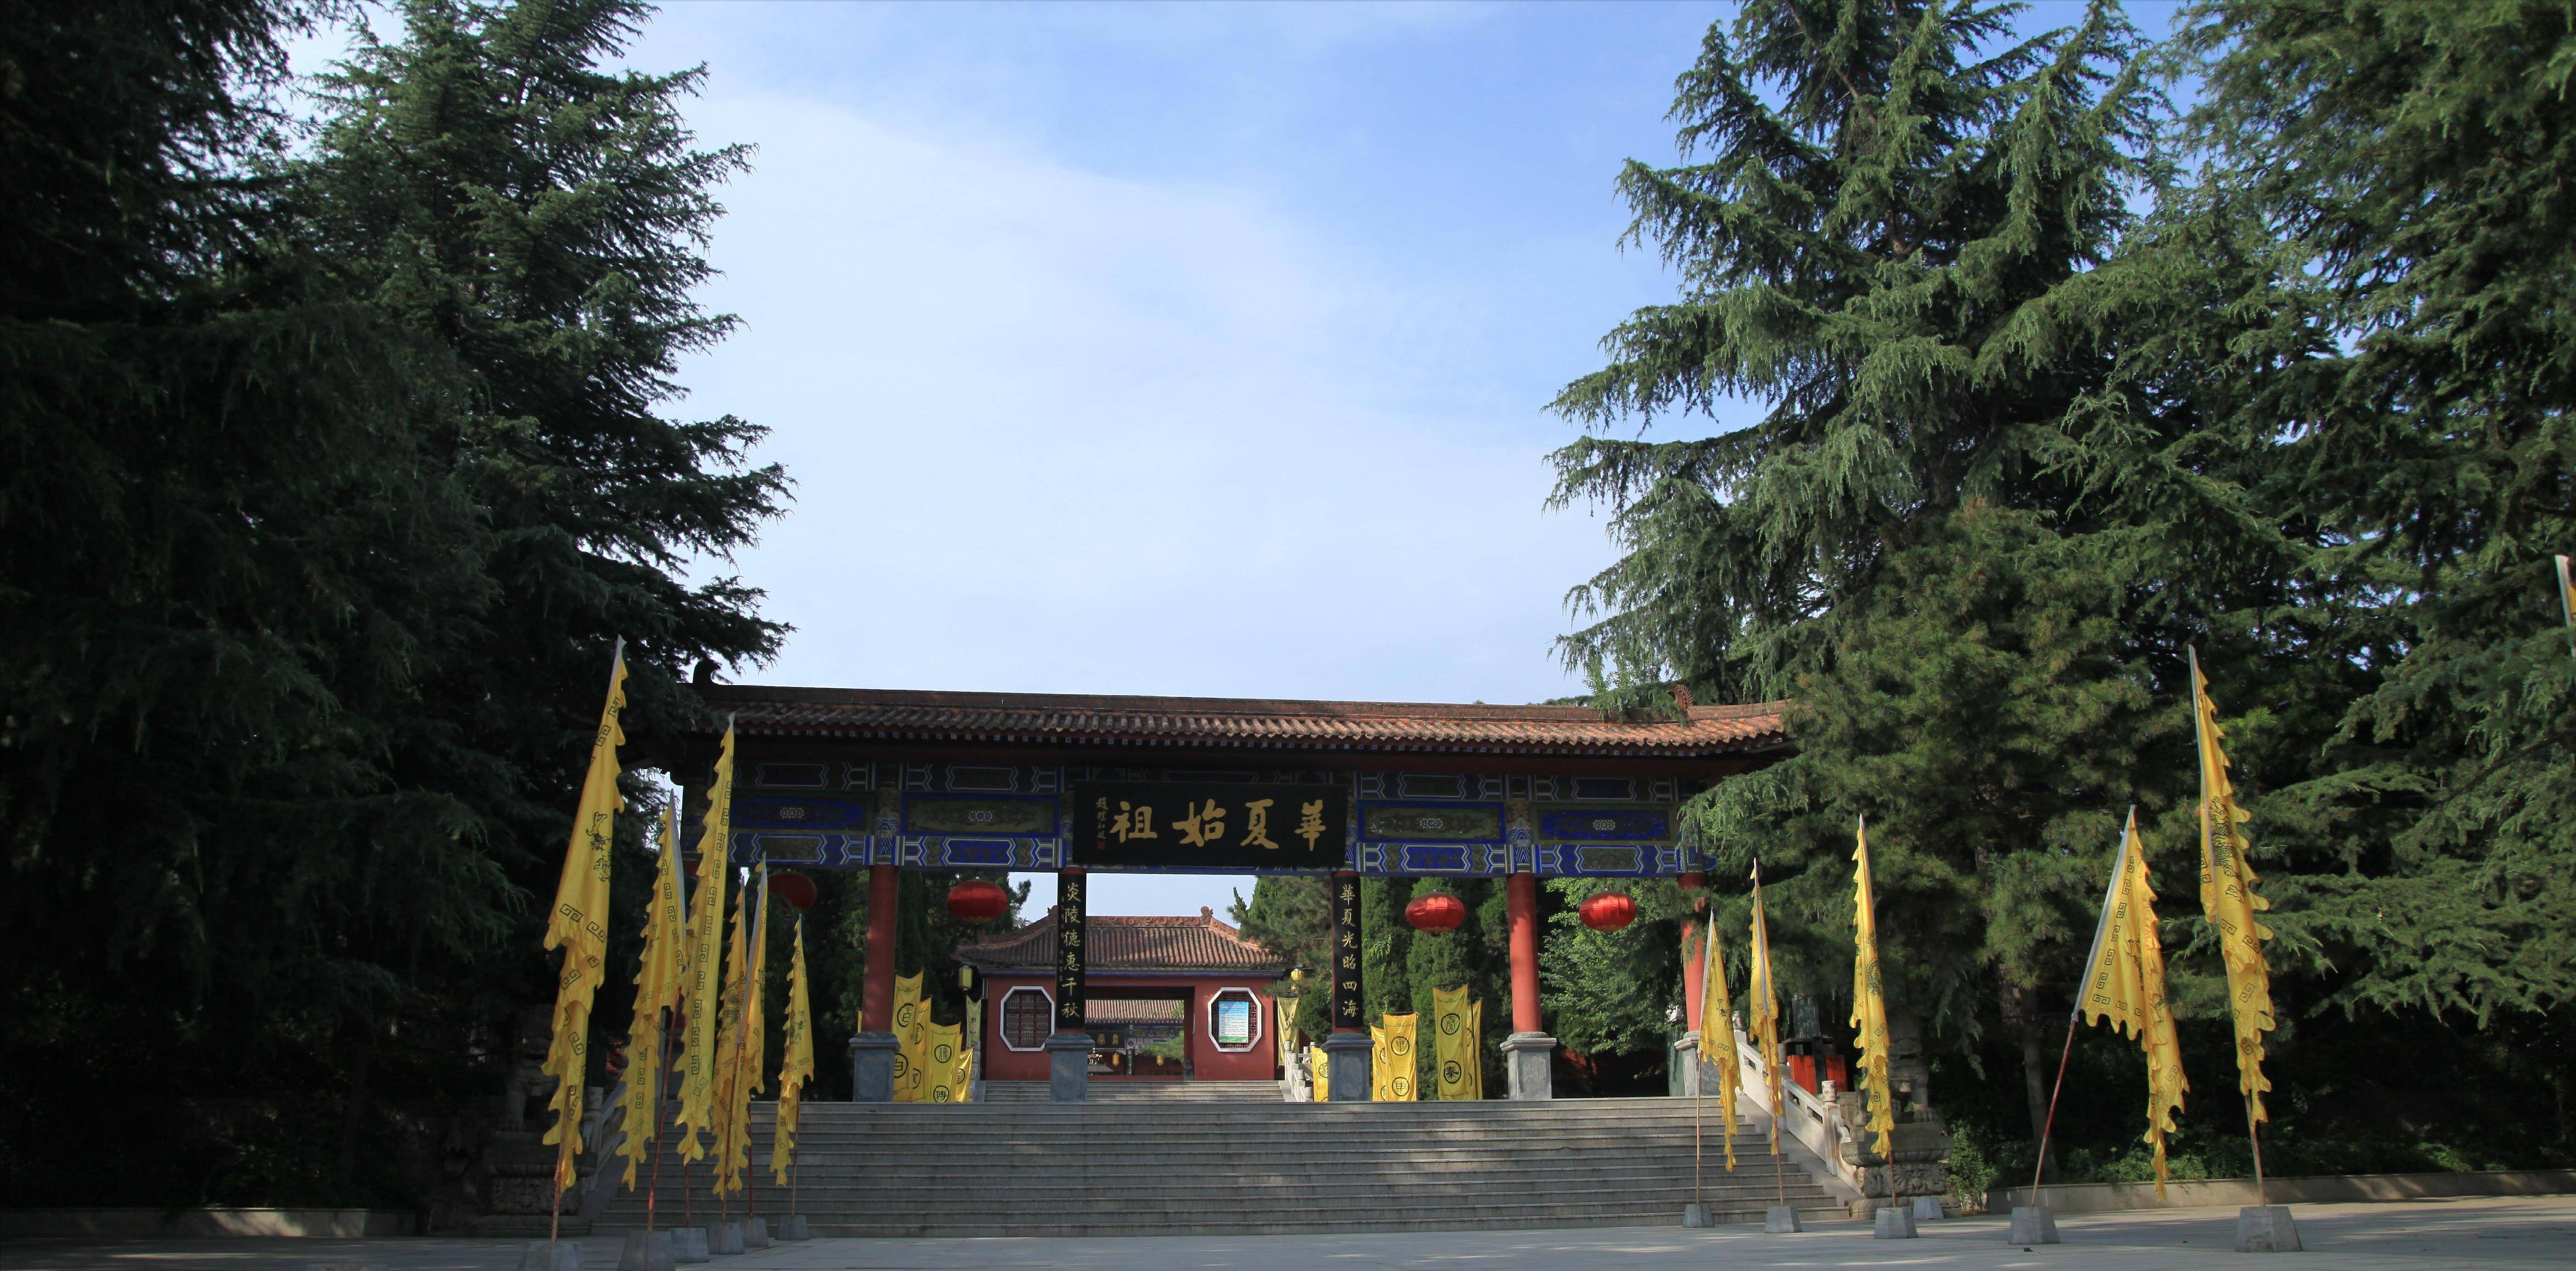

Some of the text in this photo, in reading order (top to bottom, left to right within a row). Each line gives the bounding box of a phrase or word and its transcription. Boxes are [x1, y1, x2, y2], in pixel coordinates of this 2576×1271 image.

[1109, 799, 1326, 851] 華夏始祖
[1339, 884, 1358, 1017] 華夏光昭四海
